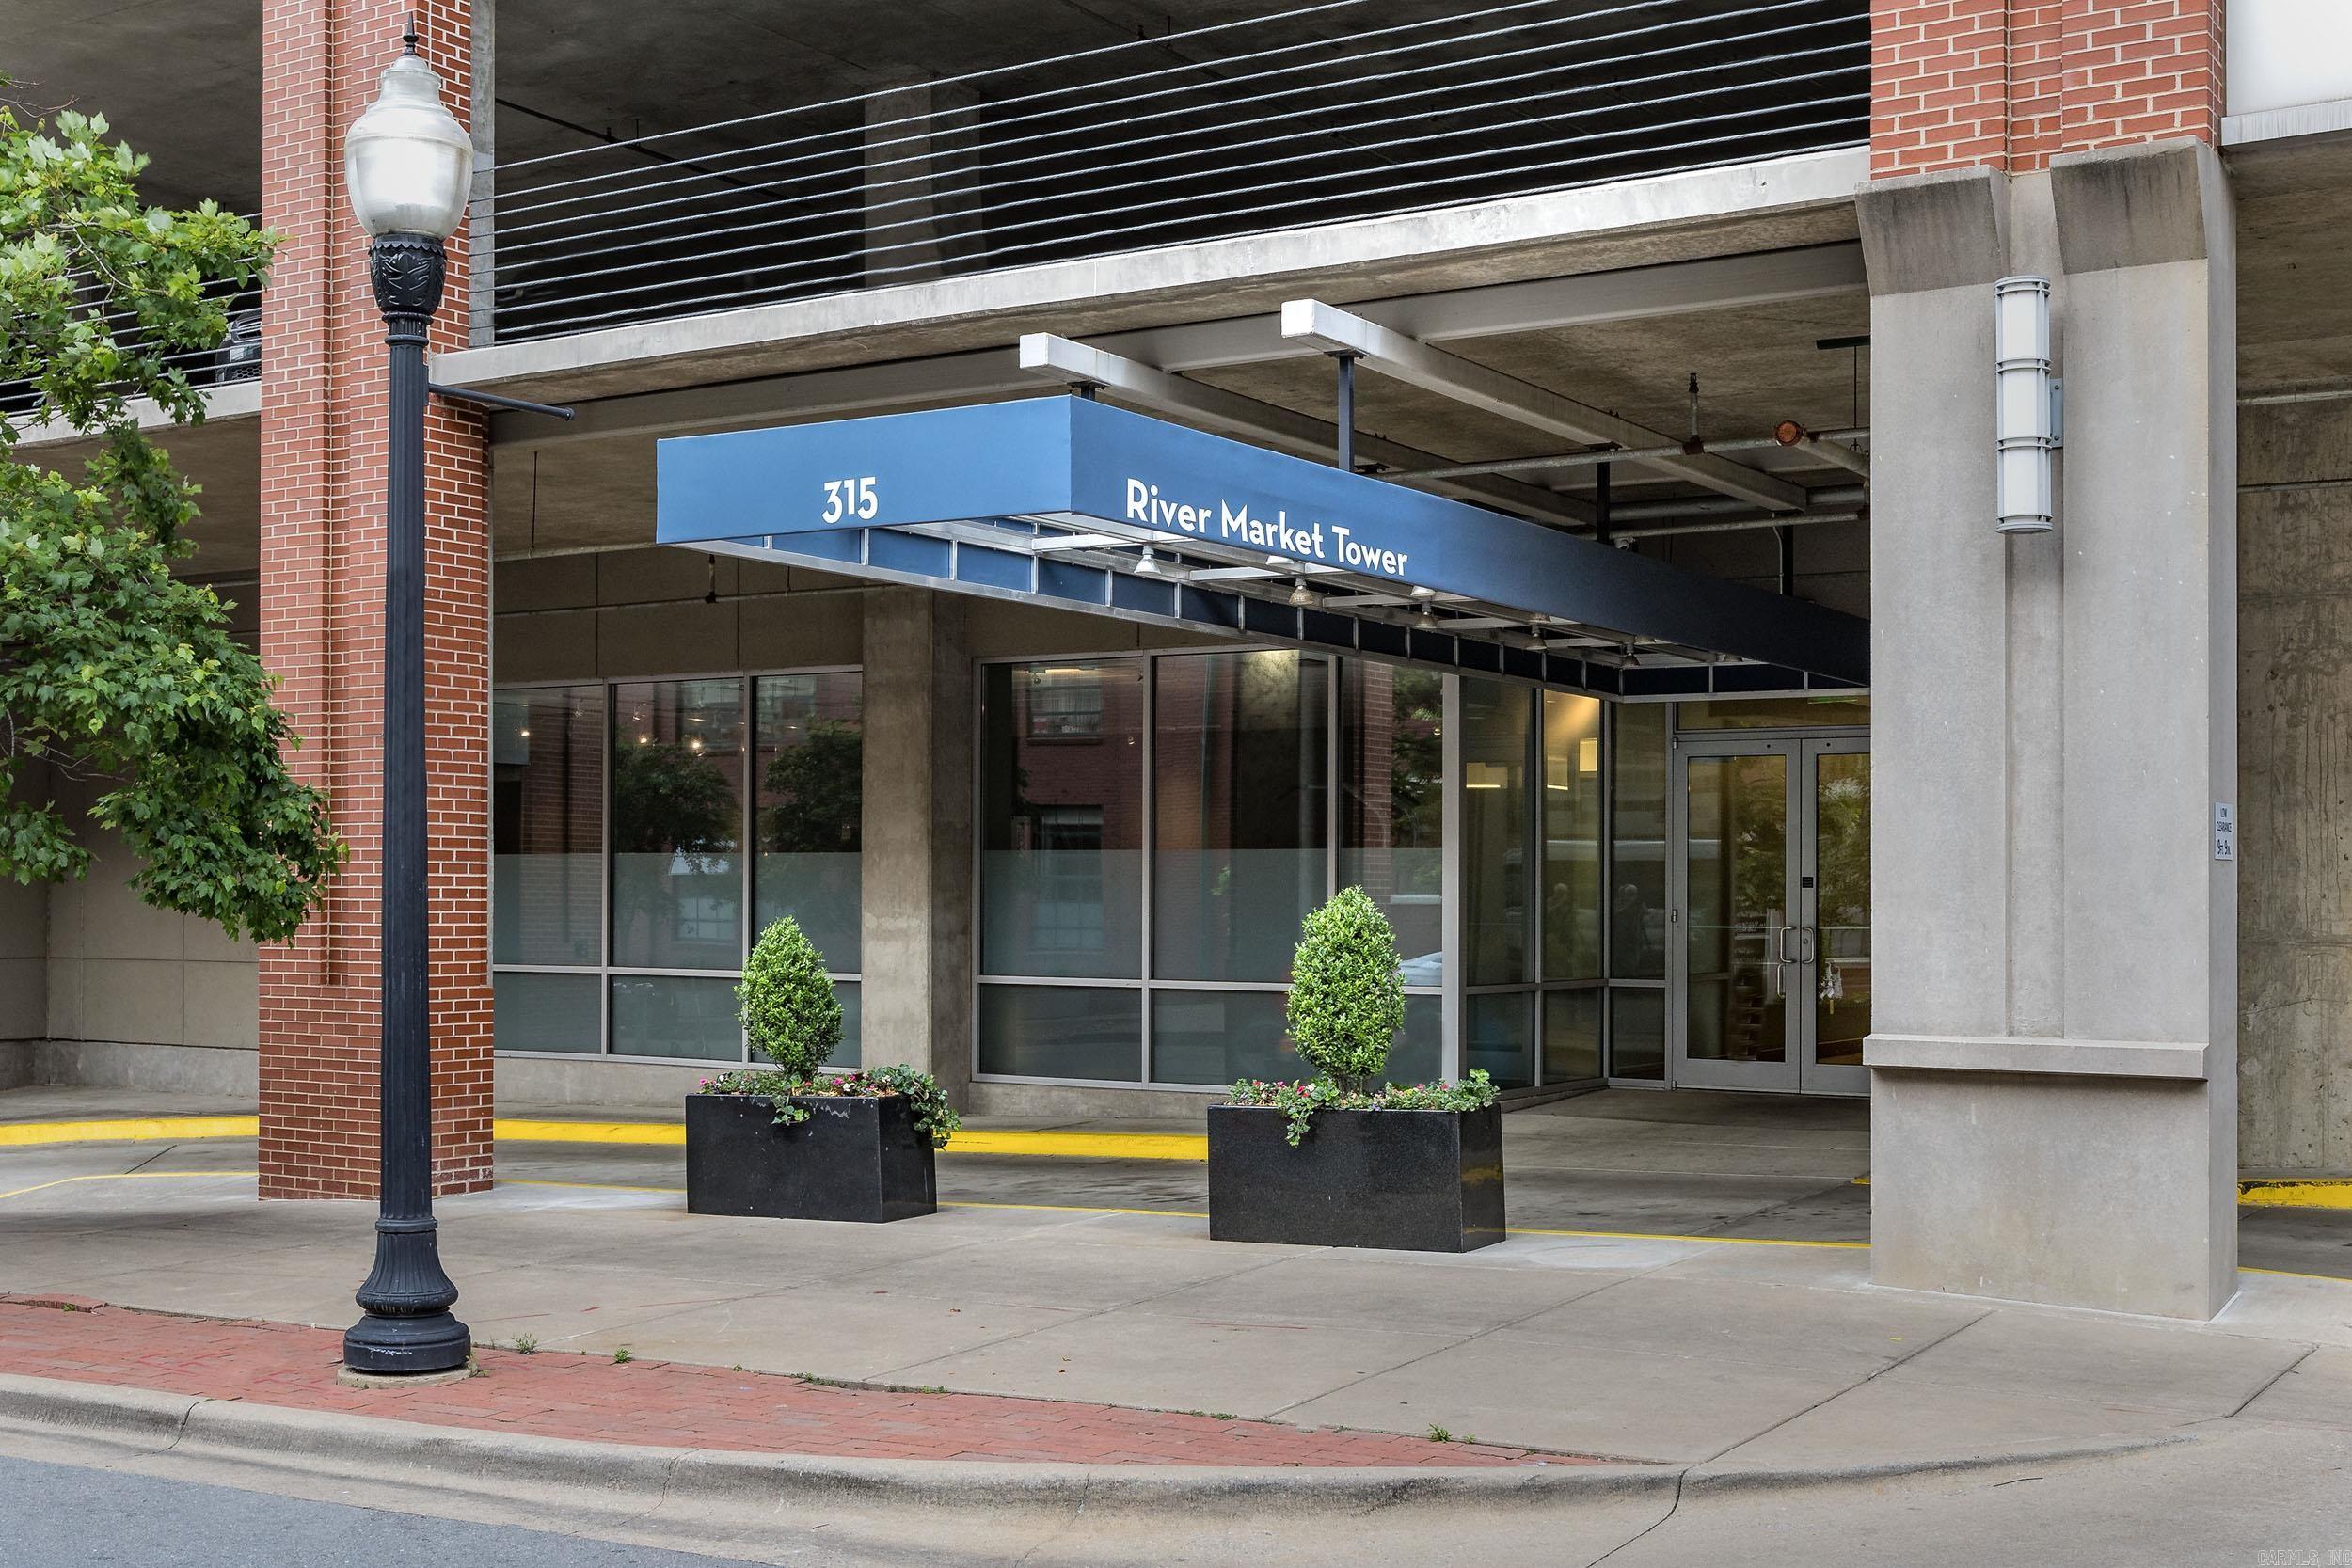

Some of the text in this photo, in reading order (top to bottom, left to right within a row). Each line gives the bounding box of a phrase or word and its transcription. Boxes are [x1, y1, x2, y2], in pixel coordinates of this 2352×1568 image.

[821, 477, 879, 524] 315
[1126, 478, 1408, 578] River Market Tower
